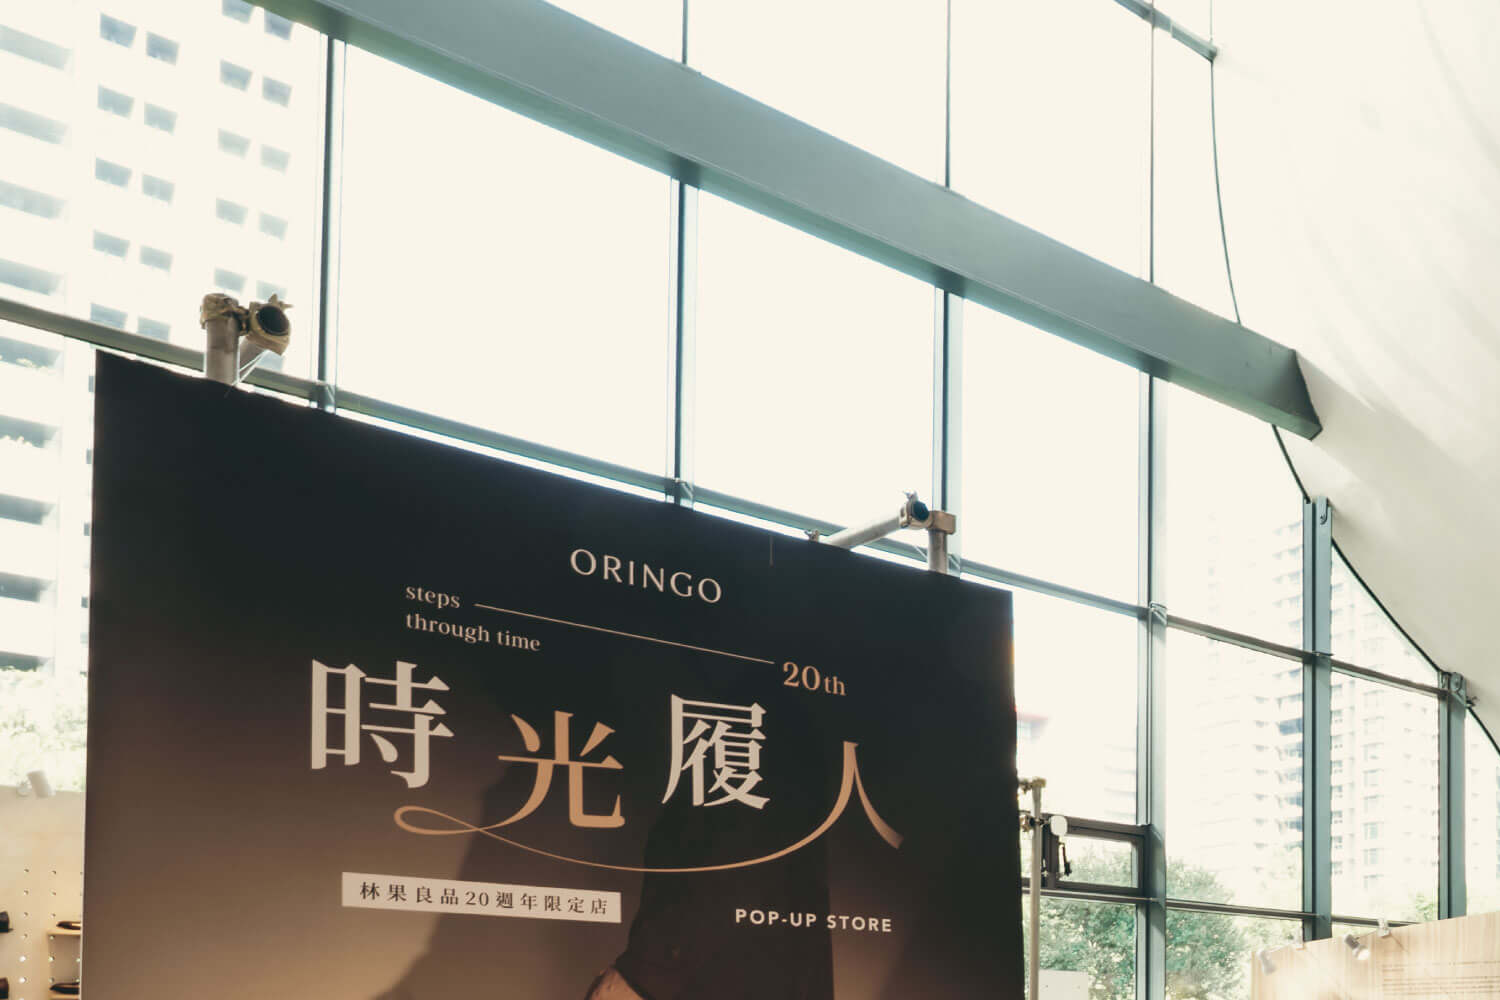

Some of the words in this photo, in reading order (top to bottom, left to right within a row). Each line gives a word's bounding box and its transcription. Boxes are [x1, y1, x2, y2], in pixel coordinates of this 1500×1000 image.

[569, 548, 722, 604] ORINGO
[405, 585, 461, 609] steps
[405, 612, 490, 643] through
[496, 629, 541, 651] time
[782, 661, 846, 696] 20th
[311, 658, 903, 873] 時光履人
[359, 881, 608, 915] 林果良品20週年限定店
[735, 908, 817, 928] POP-UP
[826, 914, 892, 933] STORE
